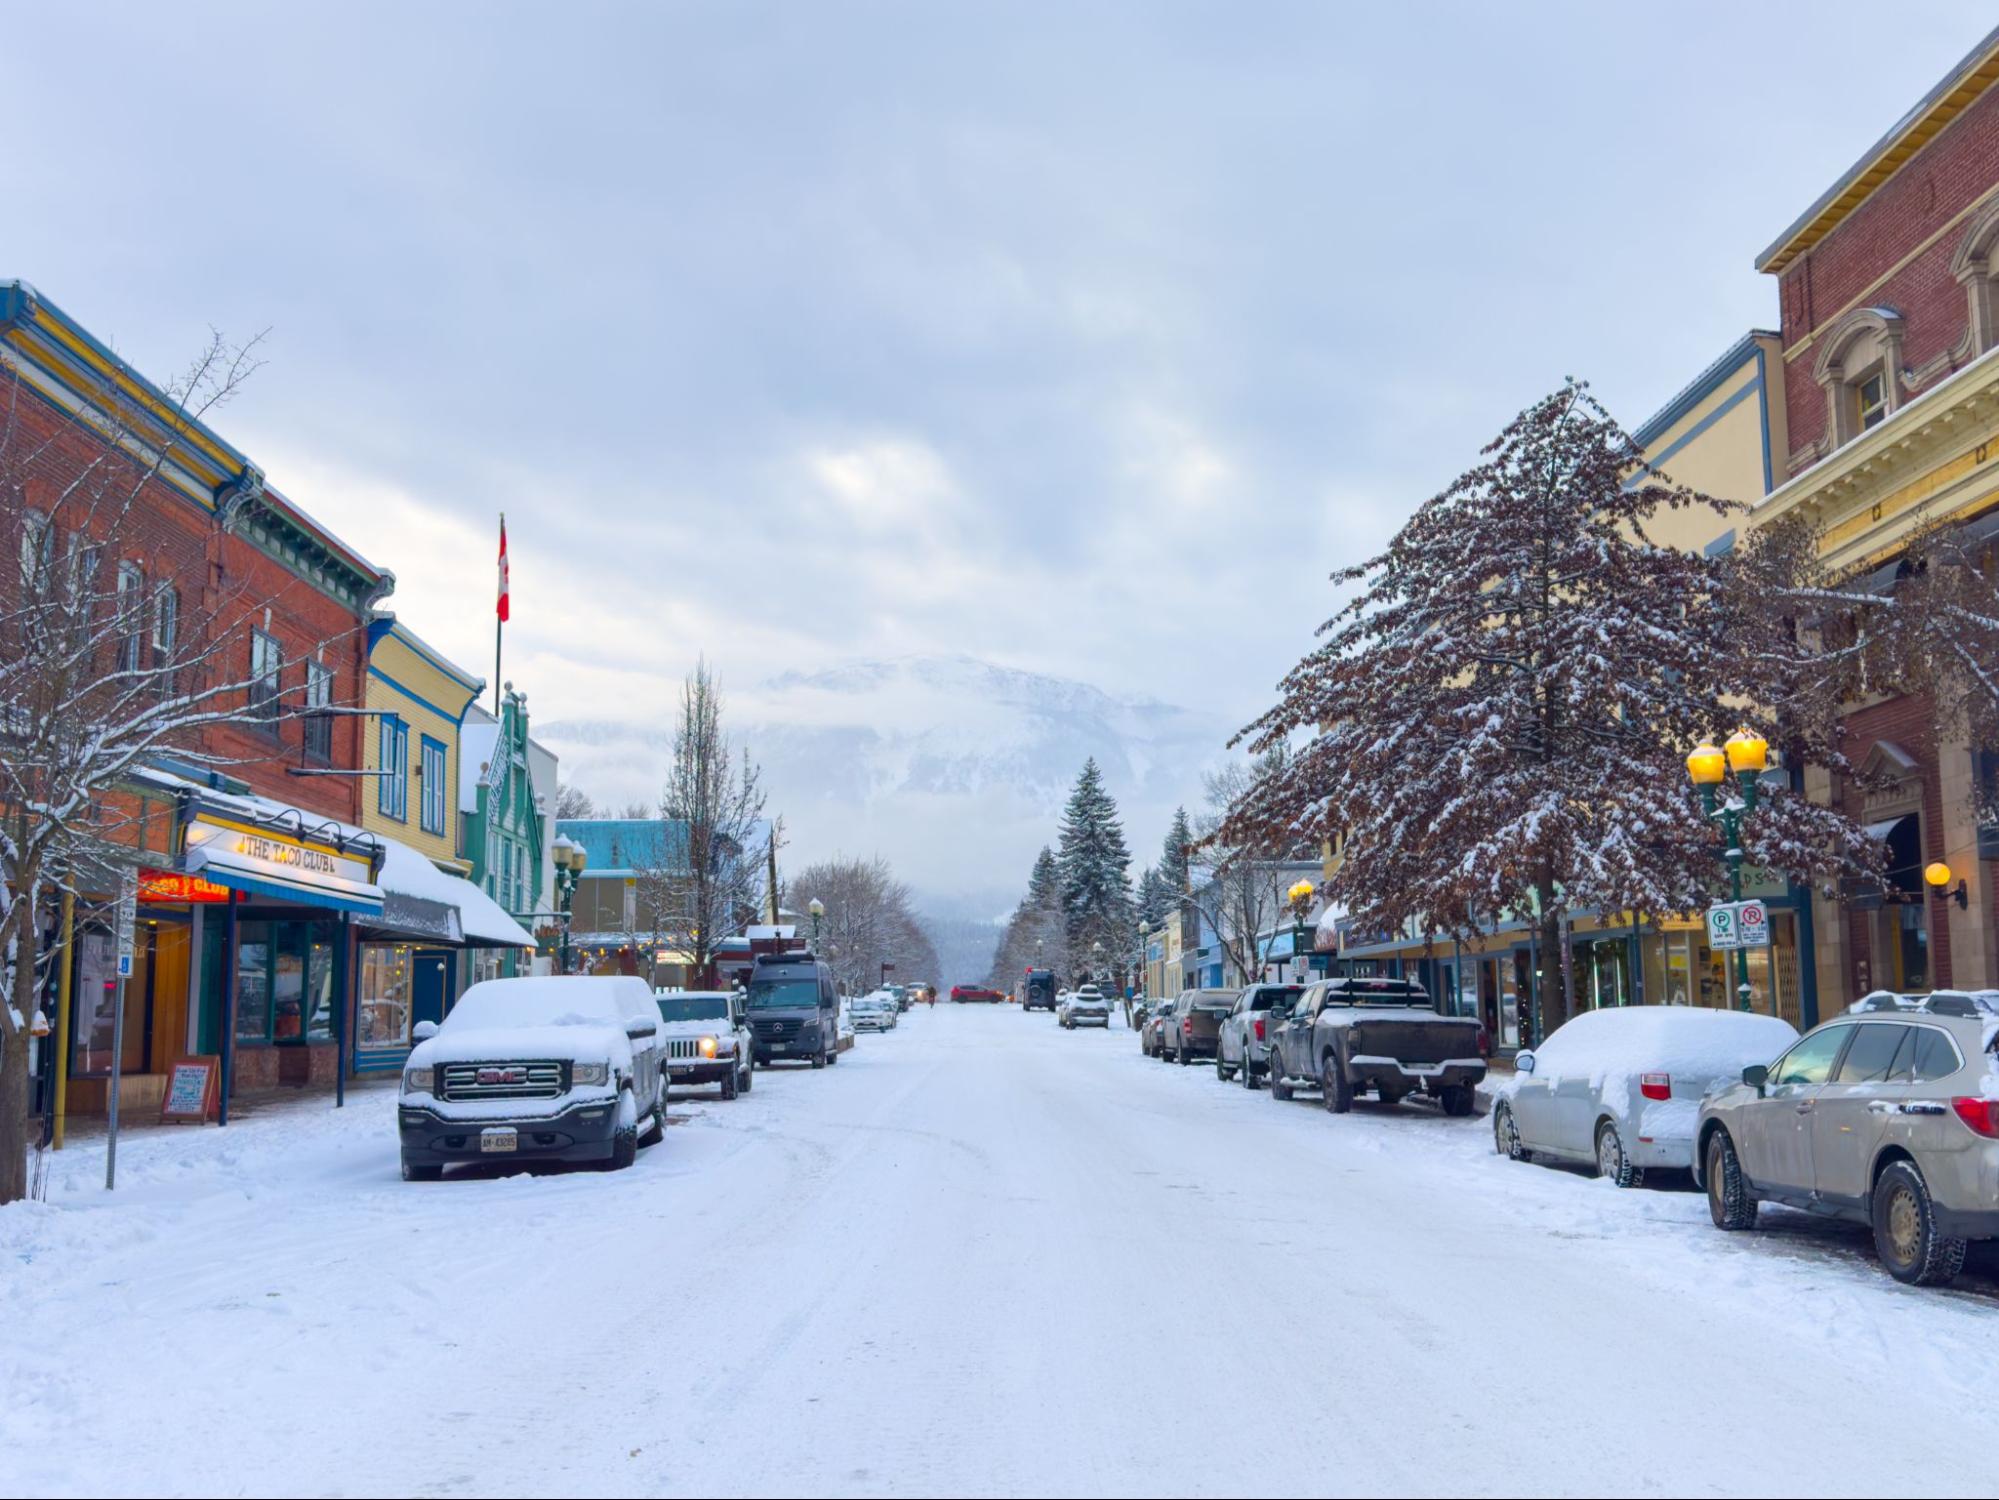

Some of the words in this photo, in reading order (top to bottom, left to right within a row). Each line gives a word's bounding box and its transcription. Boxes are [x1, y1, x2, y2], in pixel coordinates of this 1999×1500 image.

[247, 837, 269, 860] THE
[273, 844, 301, 866] TACO
[303, 851, 329, 873] CLUB
[477, 1069, 527, 1084] GMC
